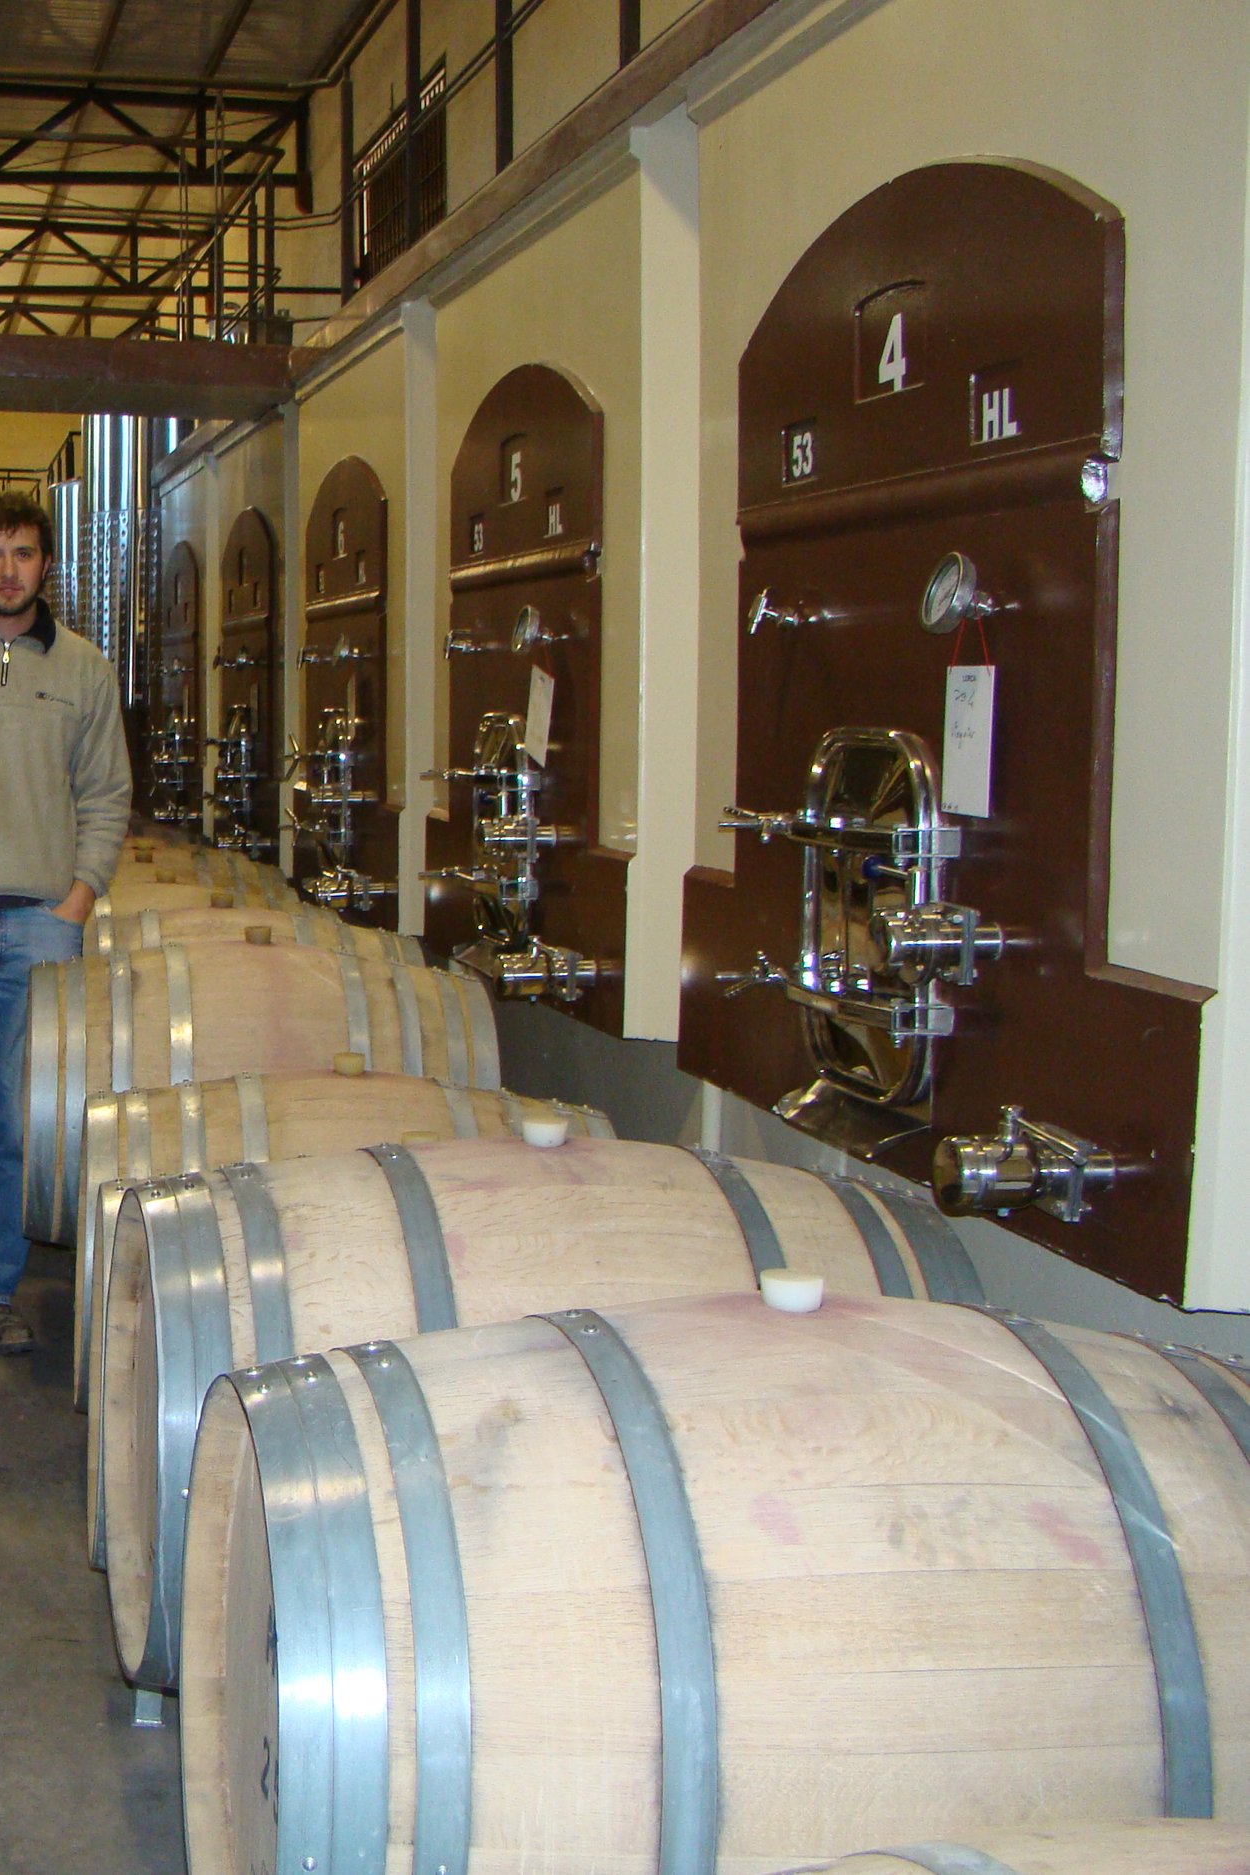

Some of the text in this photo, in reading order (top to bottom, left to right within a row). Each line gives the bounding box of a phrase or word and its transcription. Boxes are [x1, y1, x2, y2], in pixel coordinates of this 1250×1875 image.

[878, 313, 906, 392] 4
[982, 387, 1017, 442] HL
[511, 451, 522, 502] 5
[792, 432, 813, 477] 53
[473, 523, 484, 552] 53
[548, 503, 563, 535] HL
